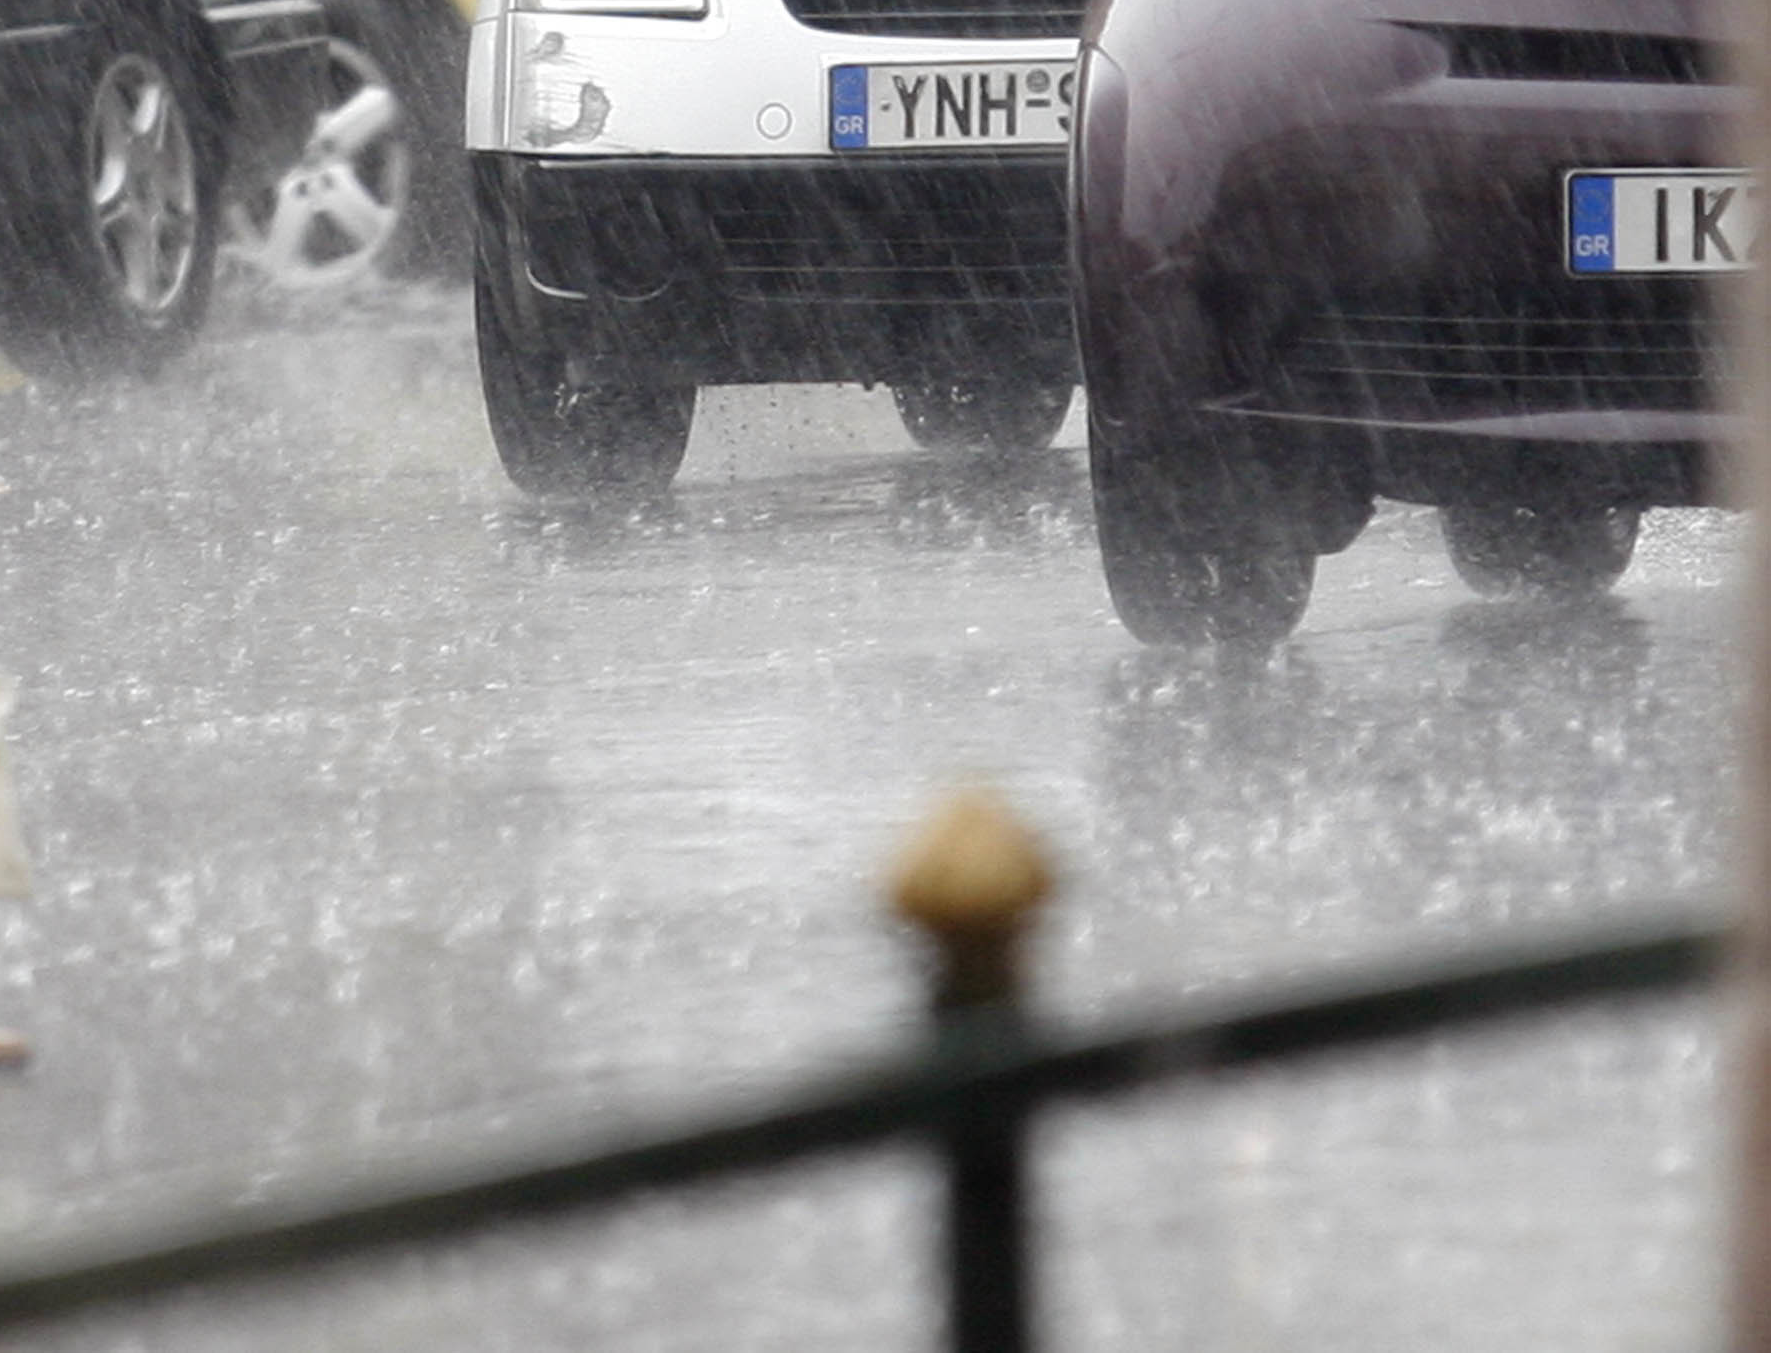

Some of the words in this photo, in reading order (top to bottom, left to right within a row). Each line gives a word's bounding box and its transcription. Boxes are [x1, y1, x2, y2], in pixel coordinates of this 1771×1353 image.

[834, 115, 866, 135] GR
[1656, 186, 1760, 263] IK
[1575, 234, 1611, 257] GR
